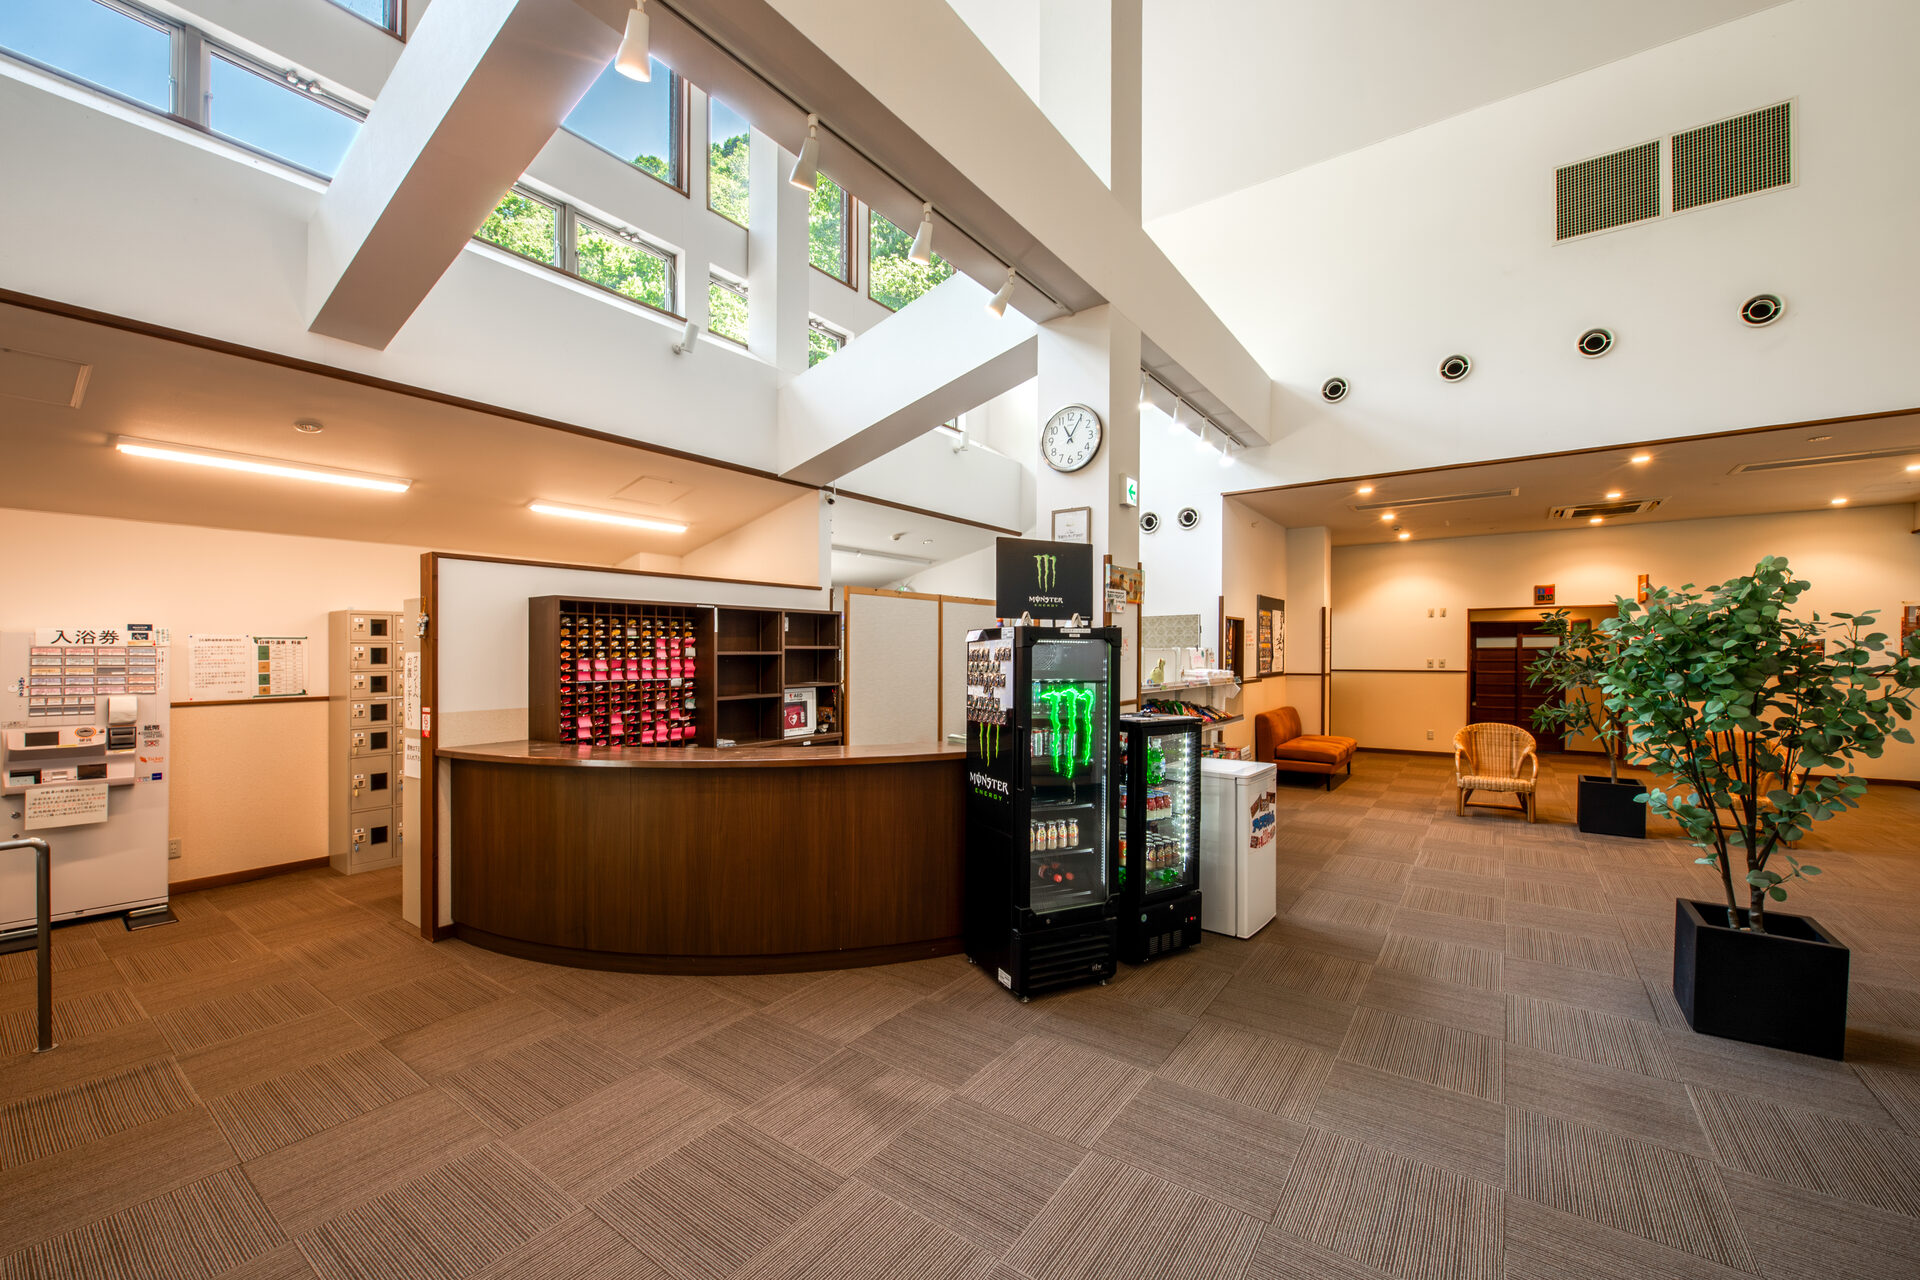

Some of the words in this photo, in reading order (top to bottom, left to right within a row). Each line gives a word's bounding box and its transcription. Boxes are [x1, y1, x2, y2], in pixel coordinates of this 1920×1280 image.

[1058, 416, 1065, 426] 11
[1067, 412, 1075, 421] 12
[1085, 419, 1091, 429] 2
[1050, 425, 1059, 436] 10
[1088, 430, 1094, 440] 3
[1048, 437, 1054, 446] 9
[1084, 442, 1090, 451] 4
[1051, 447, 1057, 457] 8
[1077, 450, 1083, 460] 5
[1059, 453, 1064, 463] 7
[1067, 455, 1074, 465] 6
[1028, 595, 1064, 604] MONSTER
[50, 629, 120, 645] 入浴券
[970, 771, 1009, 796] MONSTER
[975, 787, 1003, 801] ENERGY
